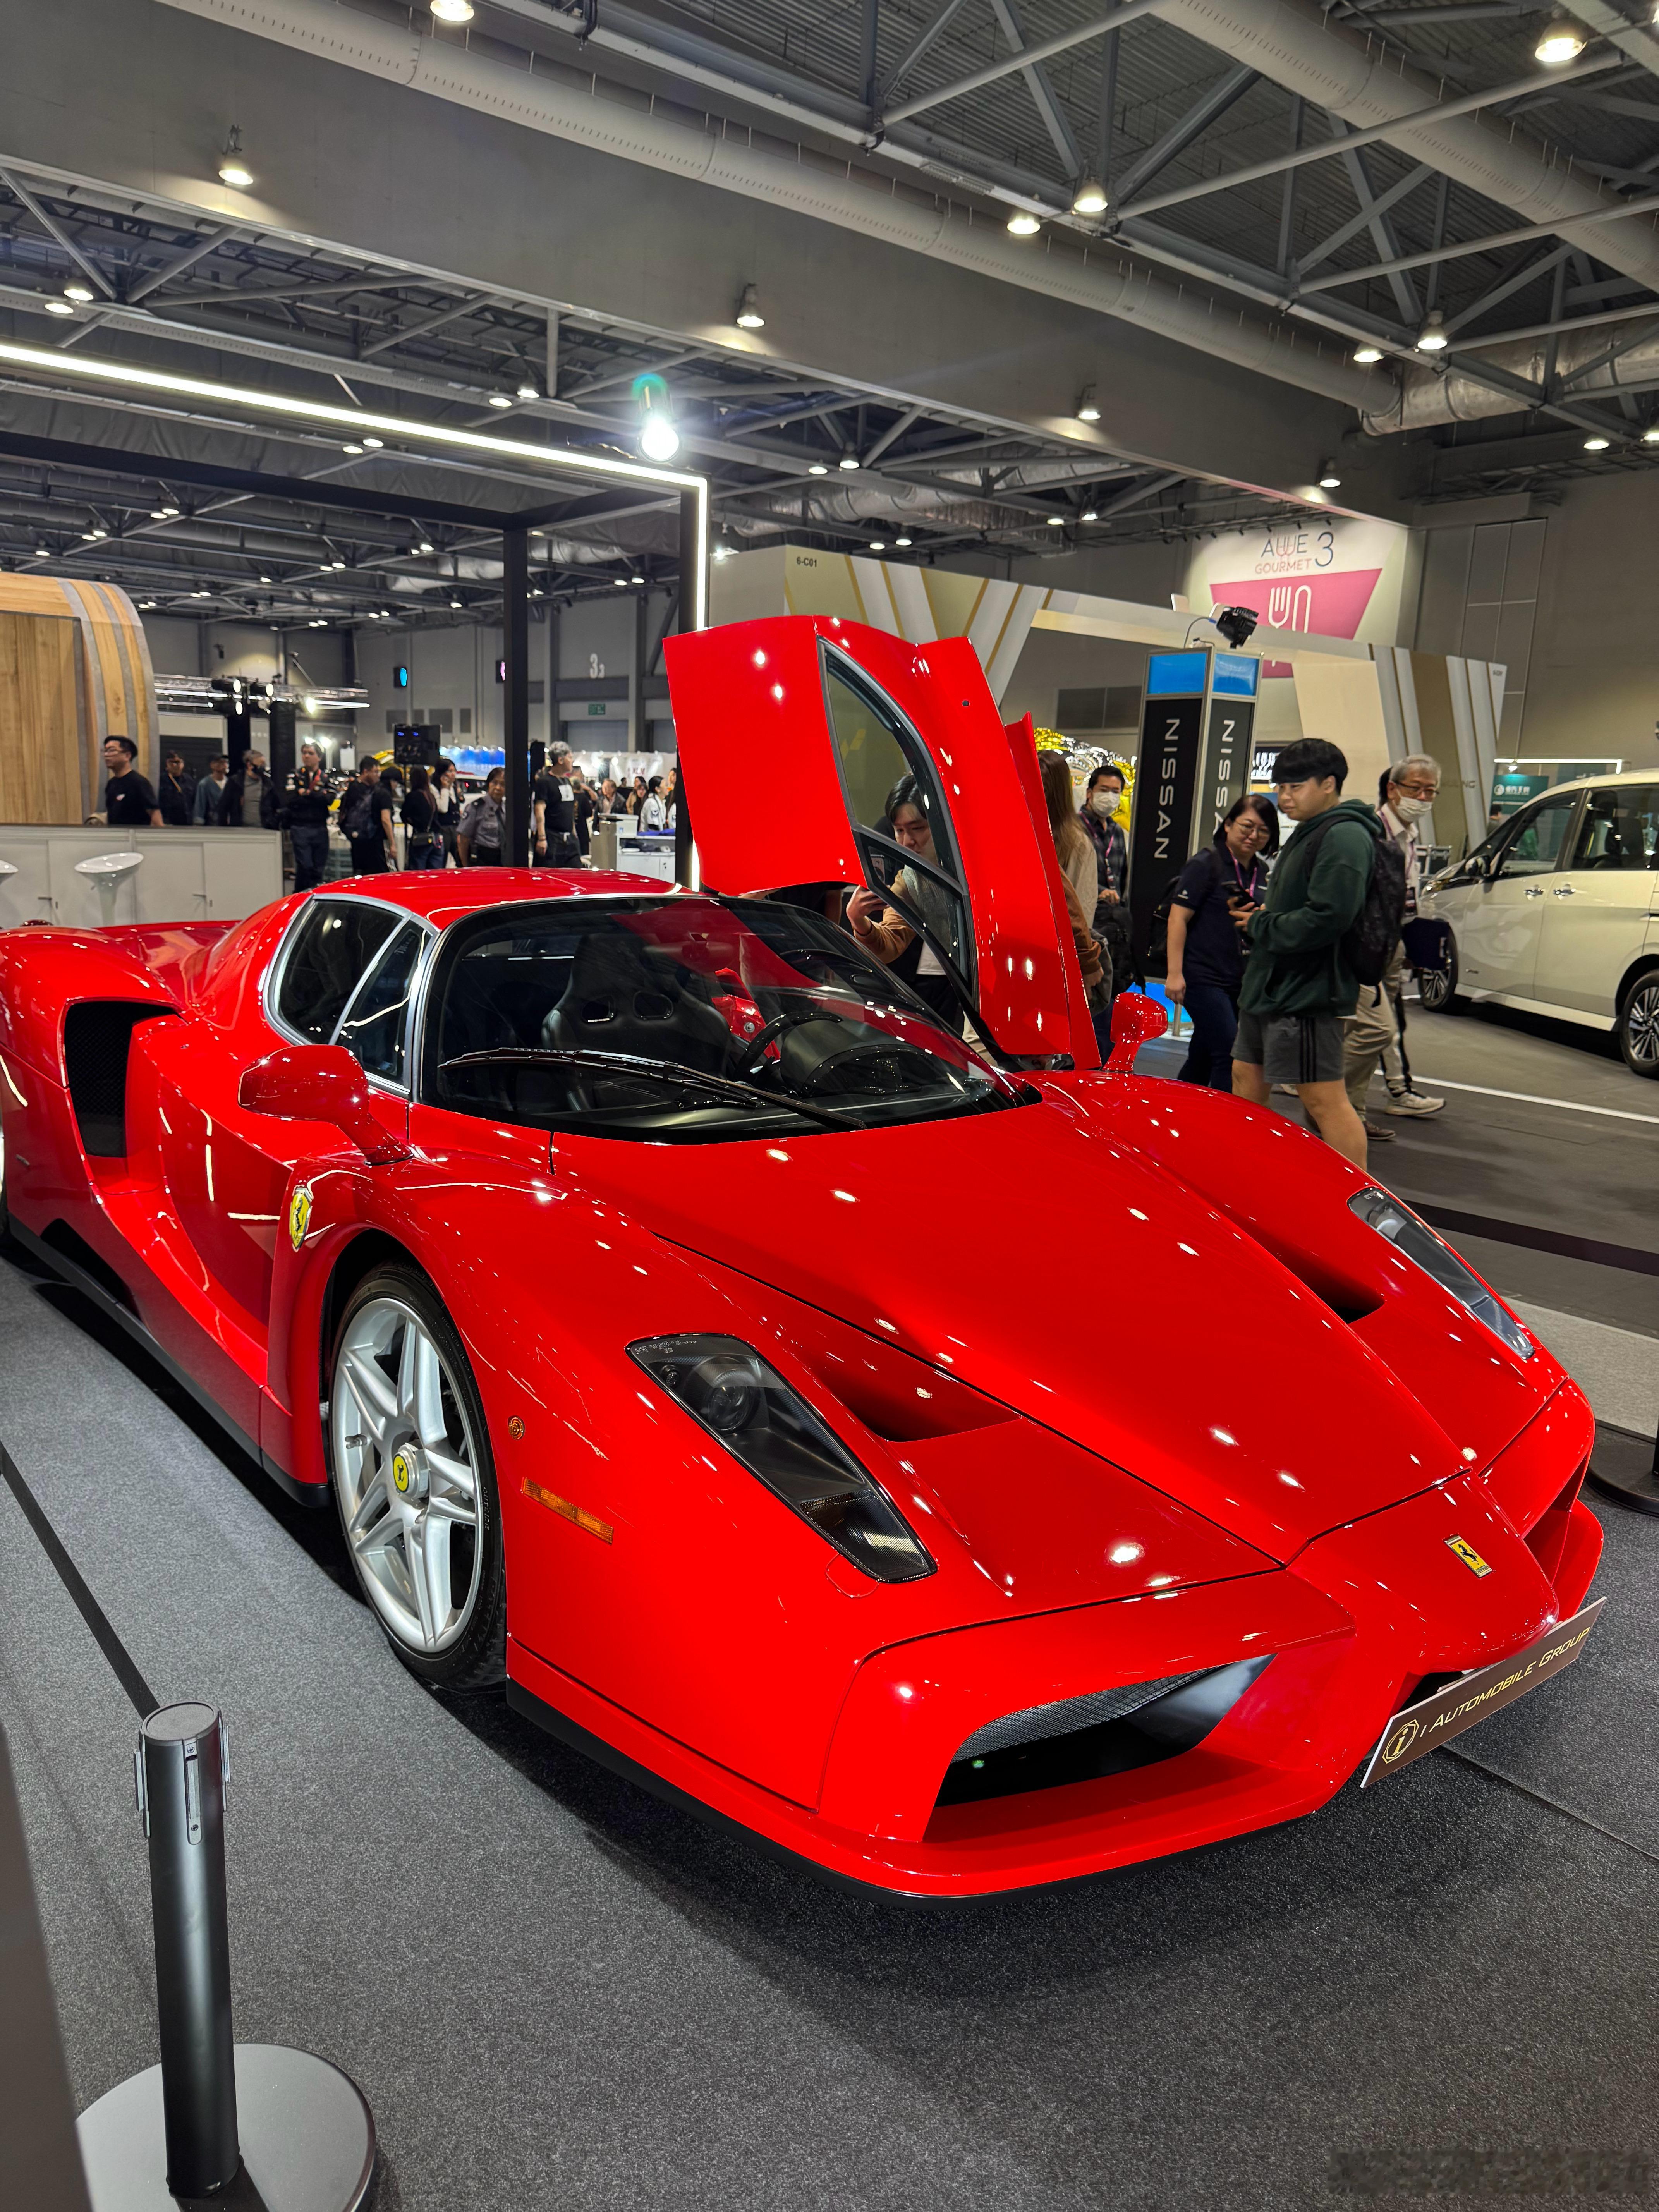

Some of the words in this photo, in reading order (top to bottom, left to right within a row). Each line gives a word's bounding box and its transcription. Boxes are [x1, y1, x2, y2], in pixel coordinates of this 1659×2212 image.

[796, 556, 817, 567] 6-C01
[1255, 558, 1312, 574] GOURMET
[1314, 532, 1334, 567] 3
[1154, 719, 1180, 859] NISSAN
[1429, 1661, 1537, 1733] AUTOMOBILE
[1539, 1627, 1590, 1668] GROUP
